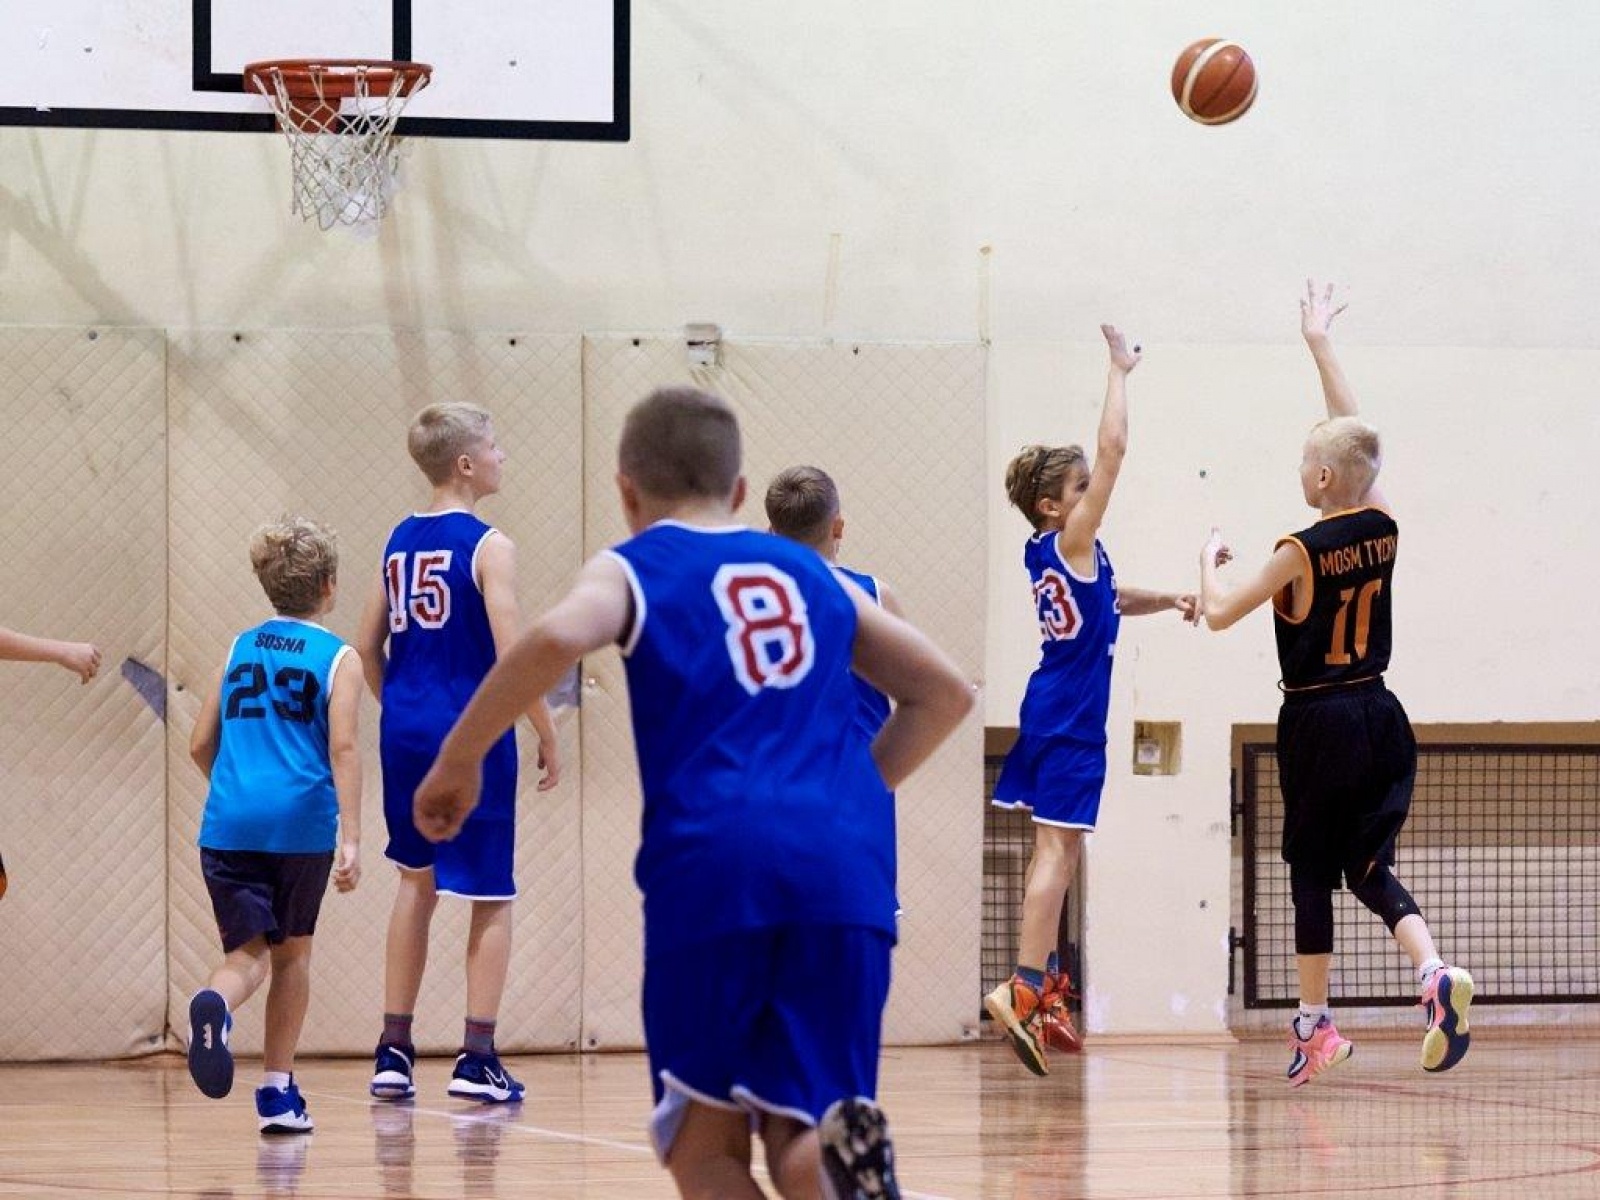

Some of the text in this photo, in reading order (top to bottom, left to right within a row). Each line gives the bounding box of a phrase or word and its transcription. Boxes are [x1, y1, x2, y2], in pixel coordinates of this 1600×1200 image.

[1320, 543, 1363, 576] MOSM
[386, 550, 453, 633] 15
[255, 632, 306, 654] SOSNA
[710, 563, 815, 696] 8
[225, 663, 320, 724] 23
